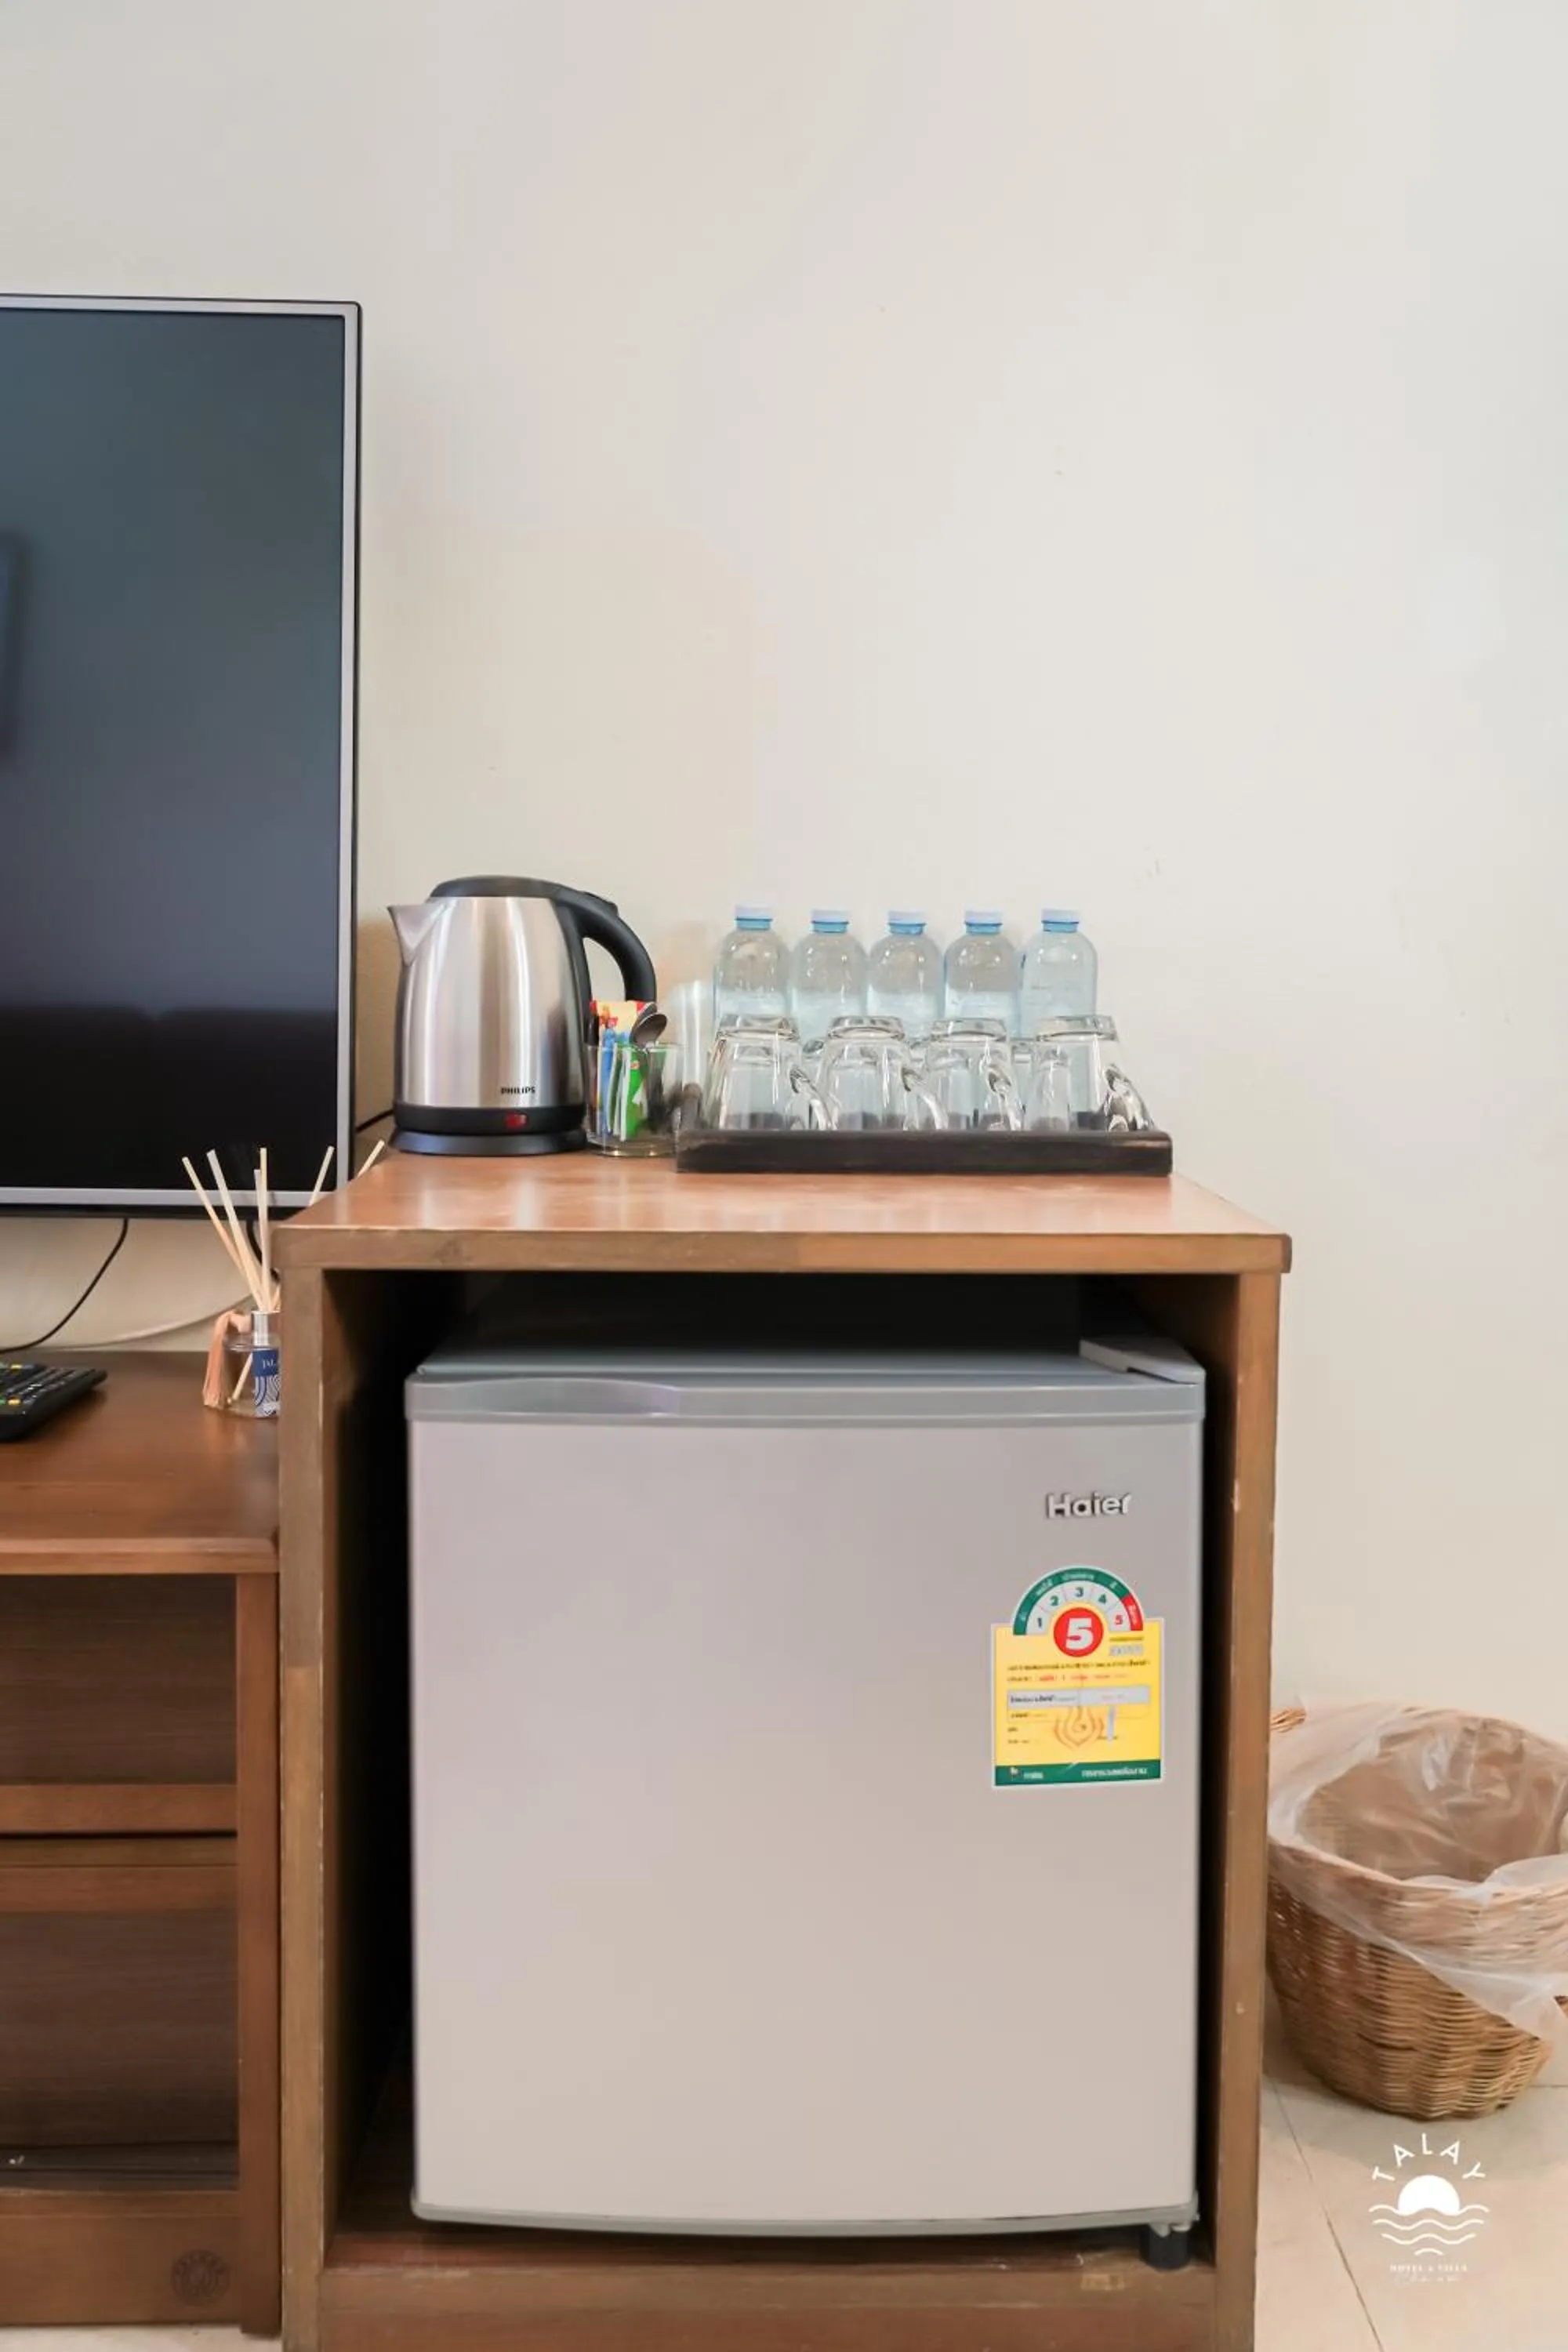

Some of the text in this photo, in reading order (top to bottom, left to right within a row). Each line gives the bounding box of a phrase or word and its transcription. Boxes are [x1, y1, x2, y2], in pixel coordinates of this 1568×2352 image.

[1046, 1491, 1132, 1519] Haier
[1051, 1596, 1059, 1606] 2
[1075, 1587, 1084, 1597] 3
[1098, 1594, 1106, 1604] 4
[1115, 1615, 1123, 1625] 5
[1065, 1617, 1094, 1650] 5
